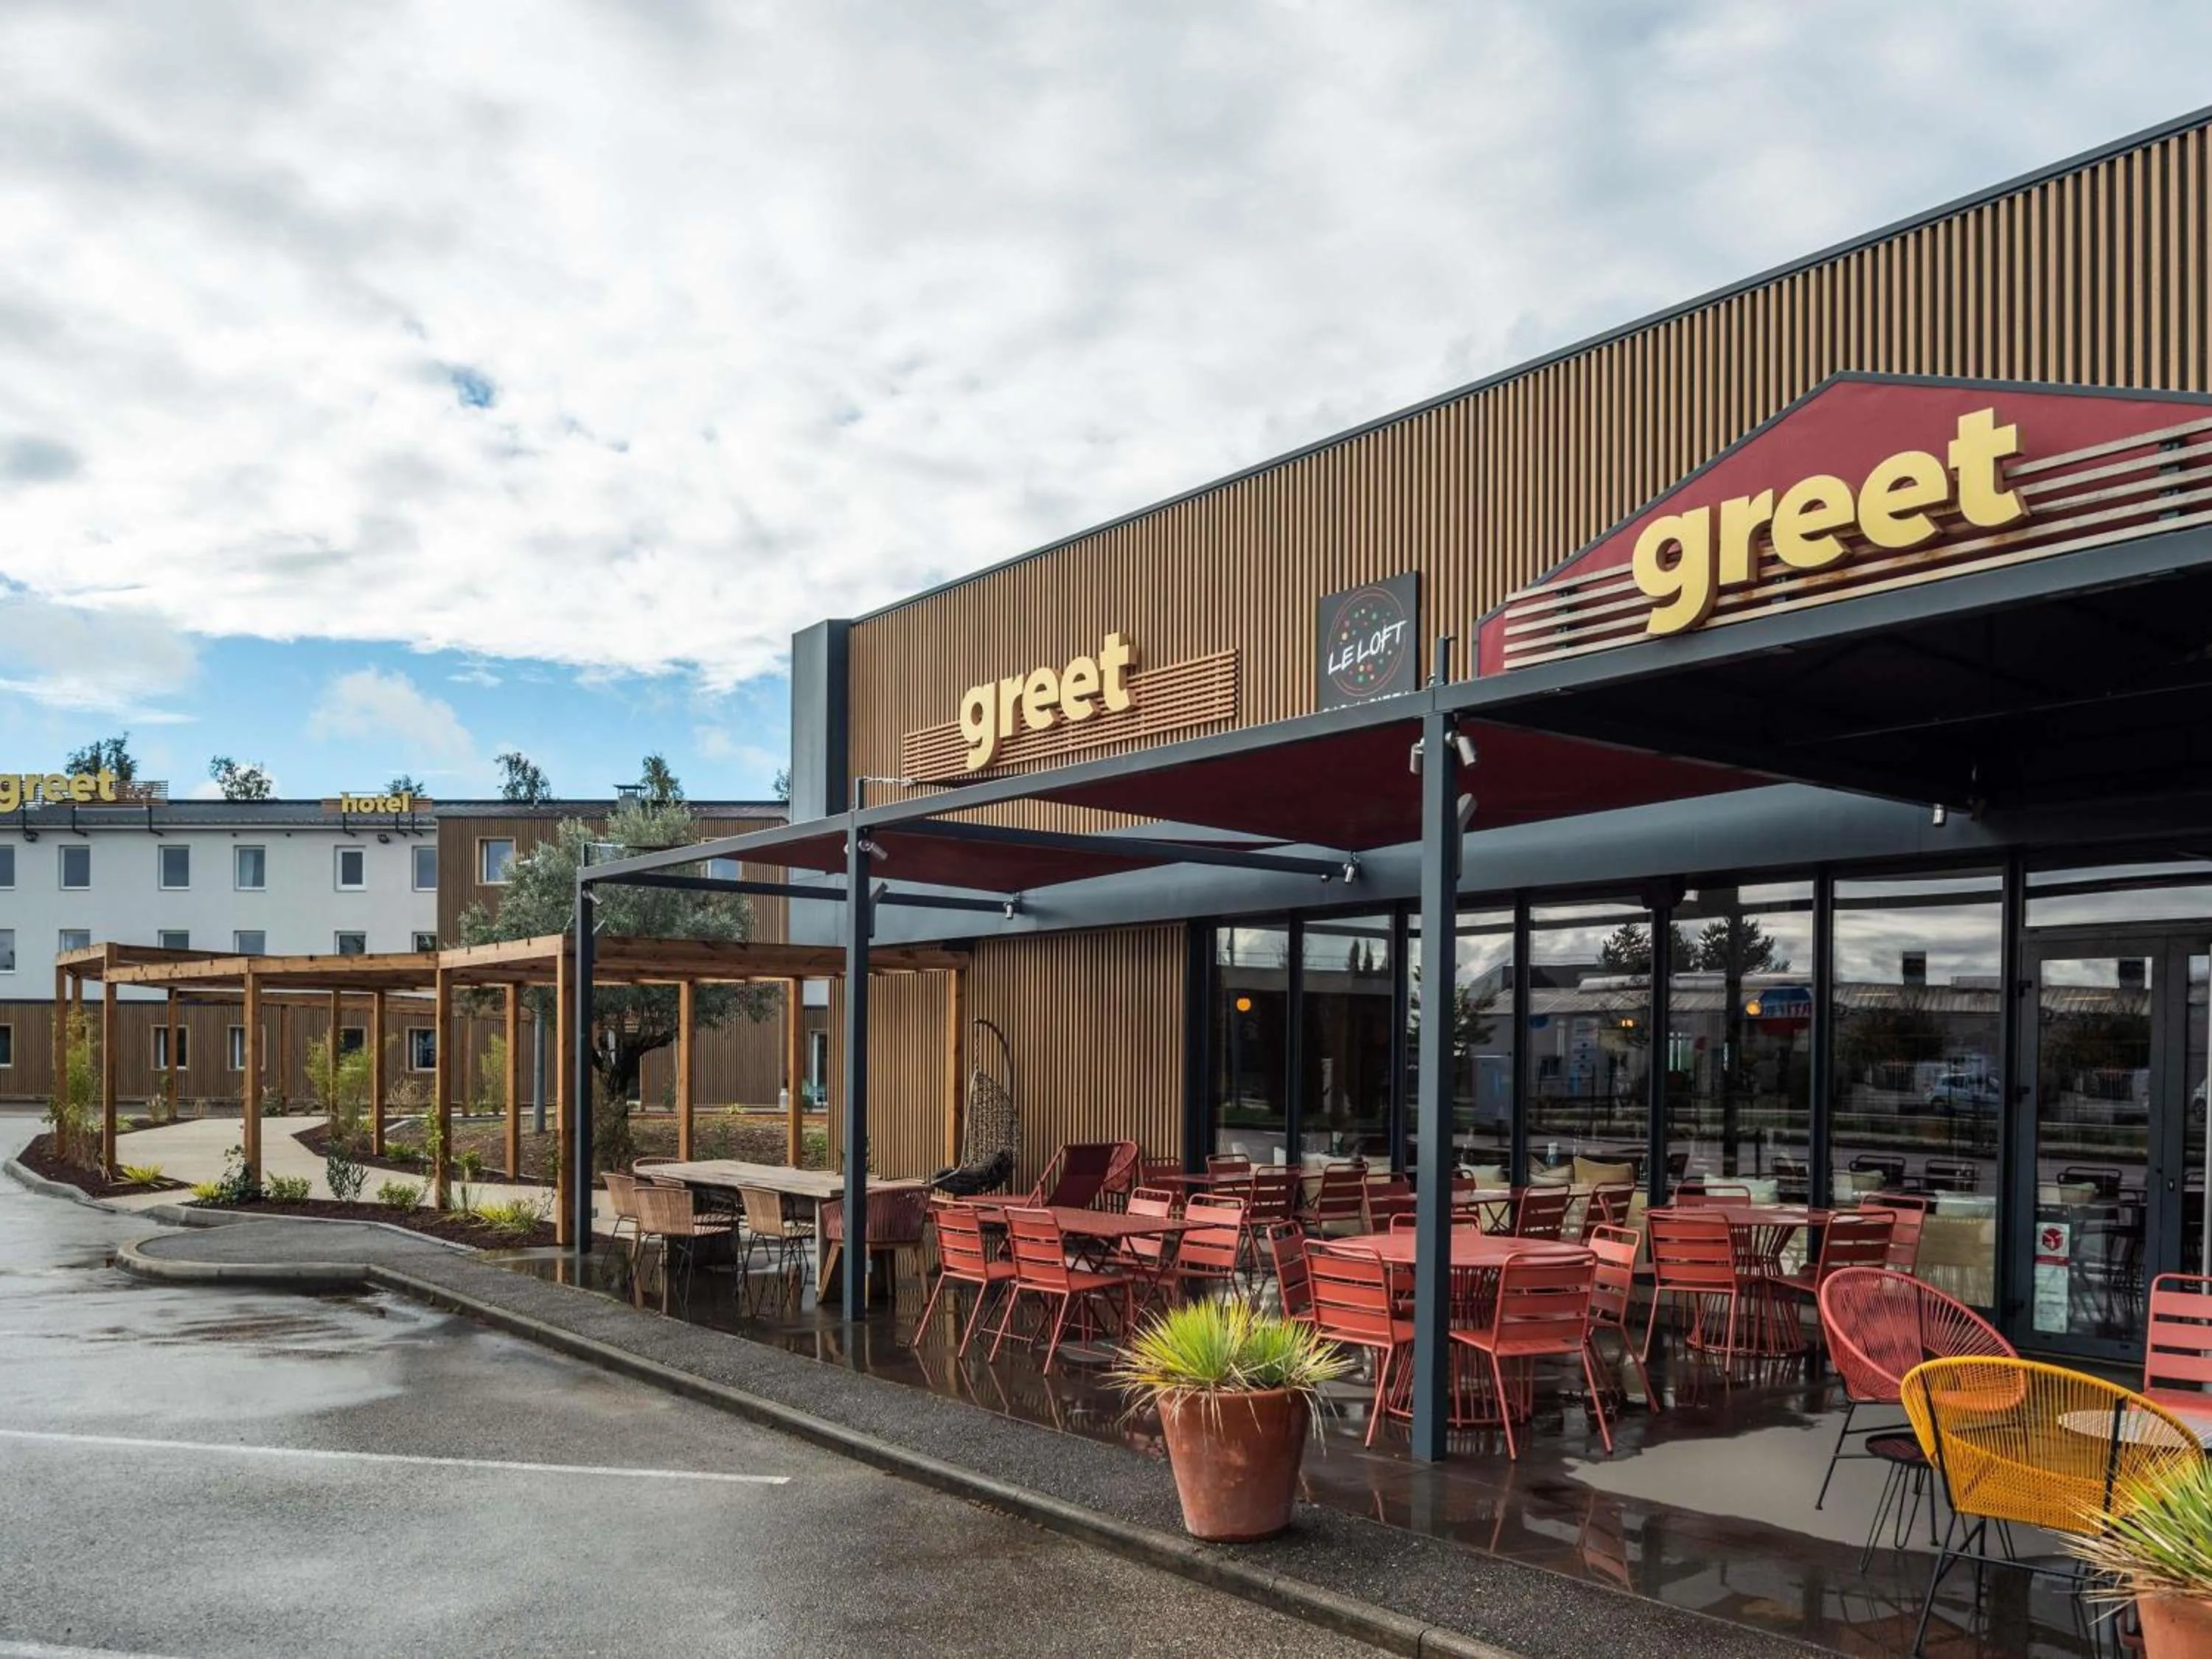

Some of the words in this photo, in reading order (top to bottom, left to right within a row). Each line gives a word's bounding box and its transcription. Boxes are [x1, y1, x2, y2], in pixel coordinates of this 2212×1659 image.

[1632, 406, 2025, 636] greet
[1327, 644, 1355, 675] LE
[1356, 619, 1408, 664] LOFT
[961, 631, 1137, 771] greet
[0, 767, 116, 813] greet
[341, 790, 411, 813] hotel
